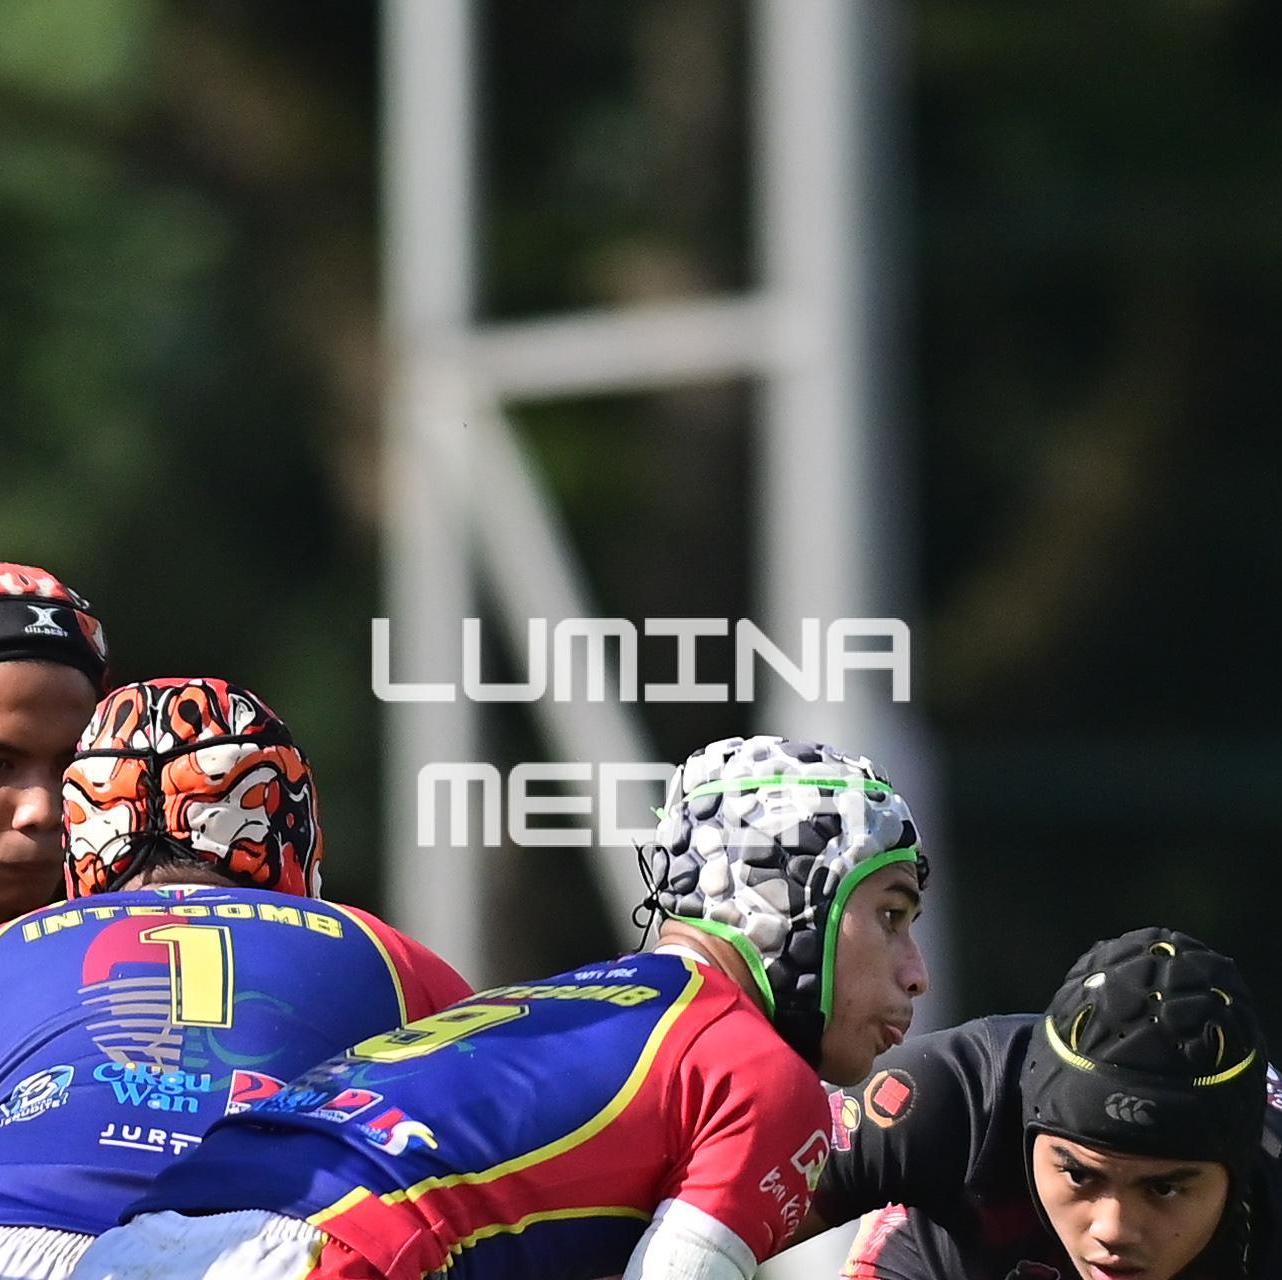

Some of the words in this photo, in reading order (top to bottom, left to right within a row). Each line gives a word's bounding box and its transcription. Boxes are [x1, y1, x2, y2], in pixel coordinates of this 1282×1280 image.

[139, 922, 234, 1029] 1
[93, 1061, 211, 1095] Cikgu
[109, 1081, 199, 1114] Wan
